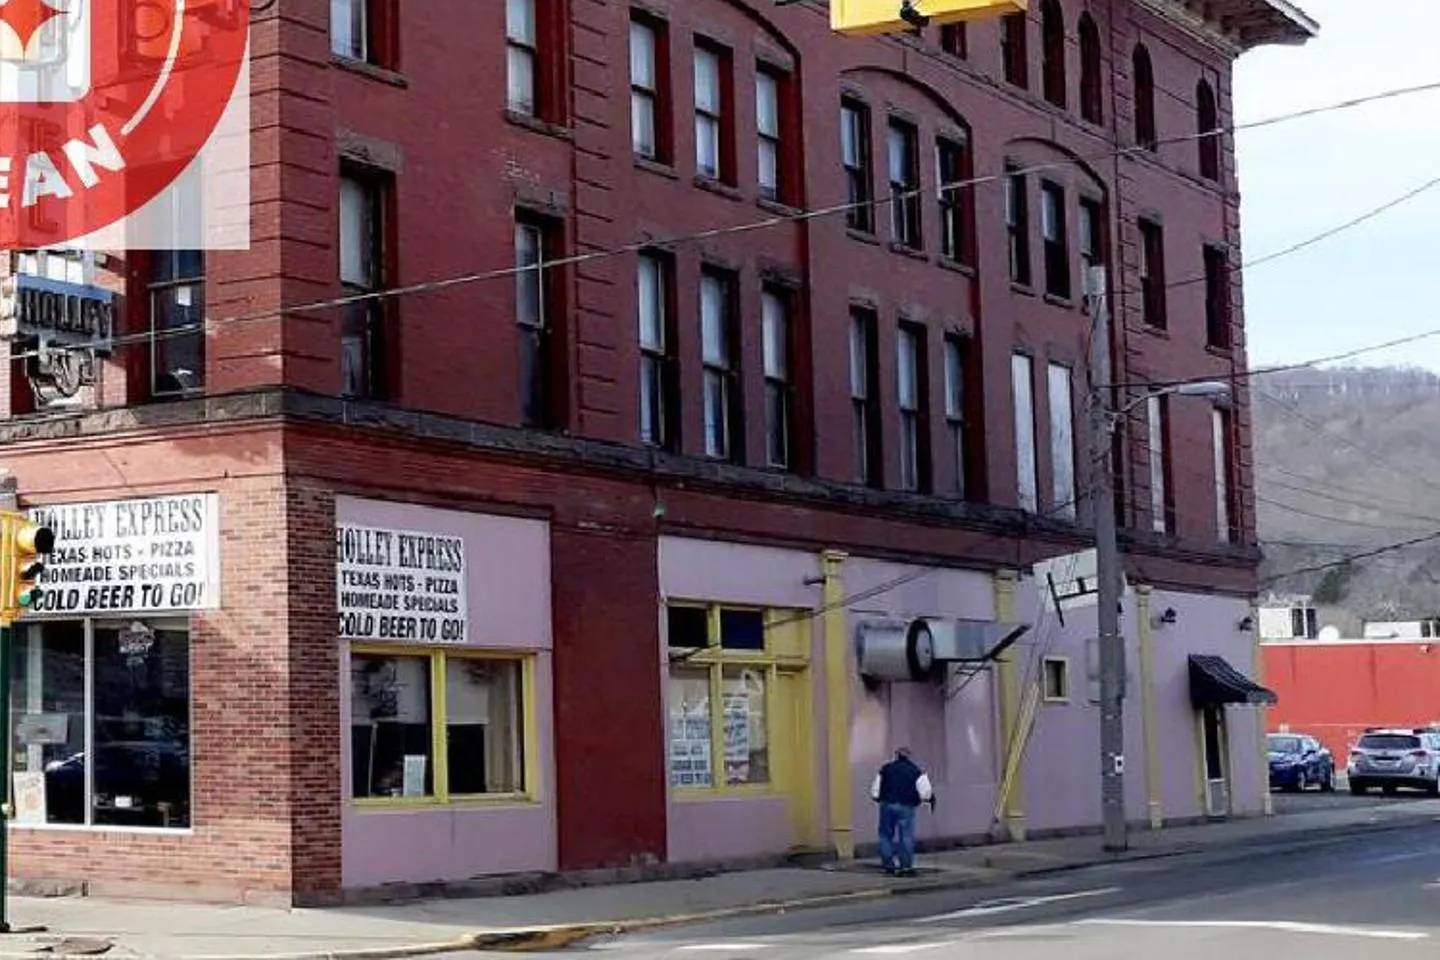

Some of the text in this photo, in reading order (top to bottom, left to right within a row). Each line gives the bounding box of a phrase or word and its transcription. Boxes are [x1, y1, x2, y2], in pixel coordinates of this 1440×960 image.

[115, 498, 203, 538] EXPRESS
[92, 543, 132, 561] HOTS
[151, 540, 195, 558] PIZZA
[398, 534, 462, 573] EXPRESS
[39, 562, 194, 584] HOMEADE SPECIALS
[341, 569, 380, 589] TEXAS
[383, 573, 415, 591] HOTS
[425, 577, 459, 594] PIZZA
[85, 584, 134, 609] BEER
[141, 583, 165, 608] TO
[169, 581, 205, 607] GO!
[341, 591, 459, 613] HOMEADE SPECIALS
[379, 615, 417, 638] BEER
[420, 617, 437, 640] TO
[441, 618, 464, 641] GO!
